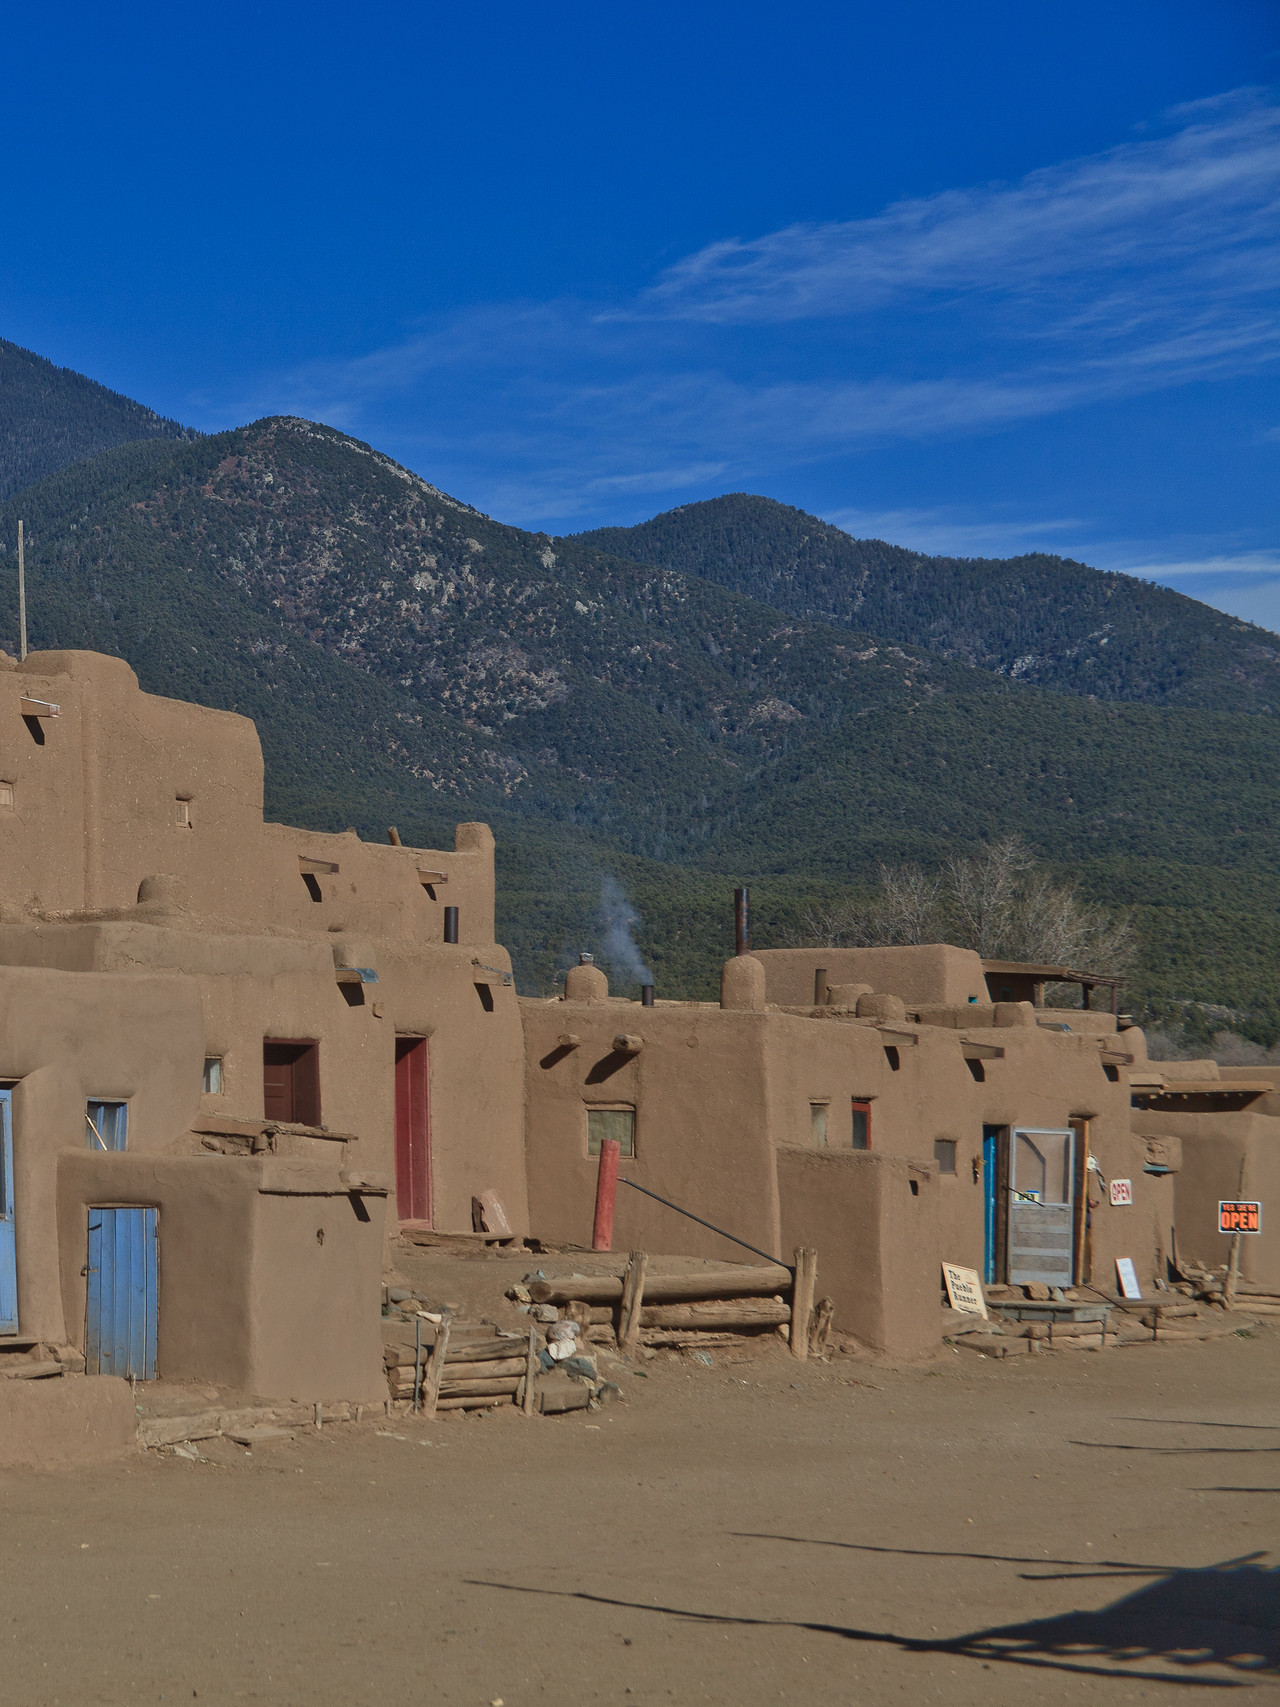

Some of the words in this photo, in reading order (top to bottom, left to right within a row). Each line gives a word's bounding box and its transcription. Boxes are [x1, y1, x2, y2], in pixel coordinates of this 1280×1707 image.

[1112, 1183, 1130, 1201] OPEN
[1222, 1203, 1235, 1211] YES
[1221, 1211, 1258, 1229] OPEN
[948, 1269, 961, 1281] The
[950, 1279, 973, 1294] Pueblo
[953, 1291, 977, 1305] Runner
